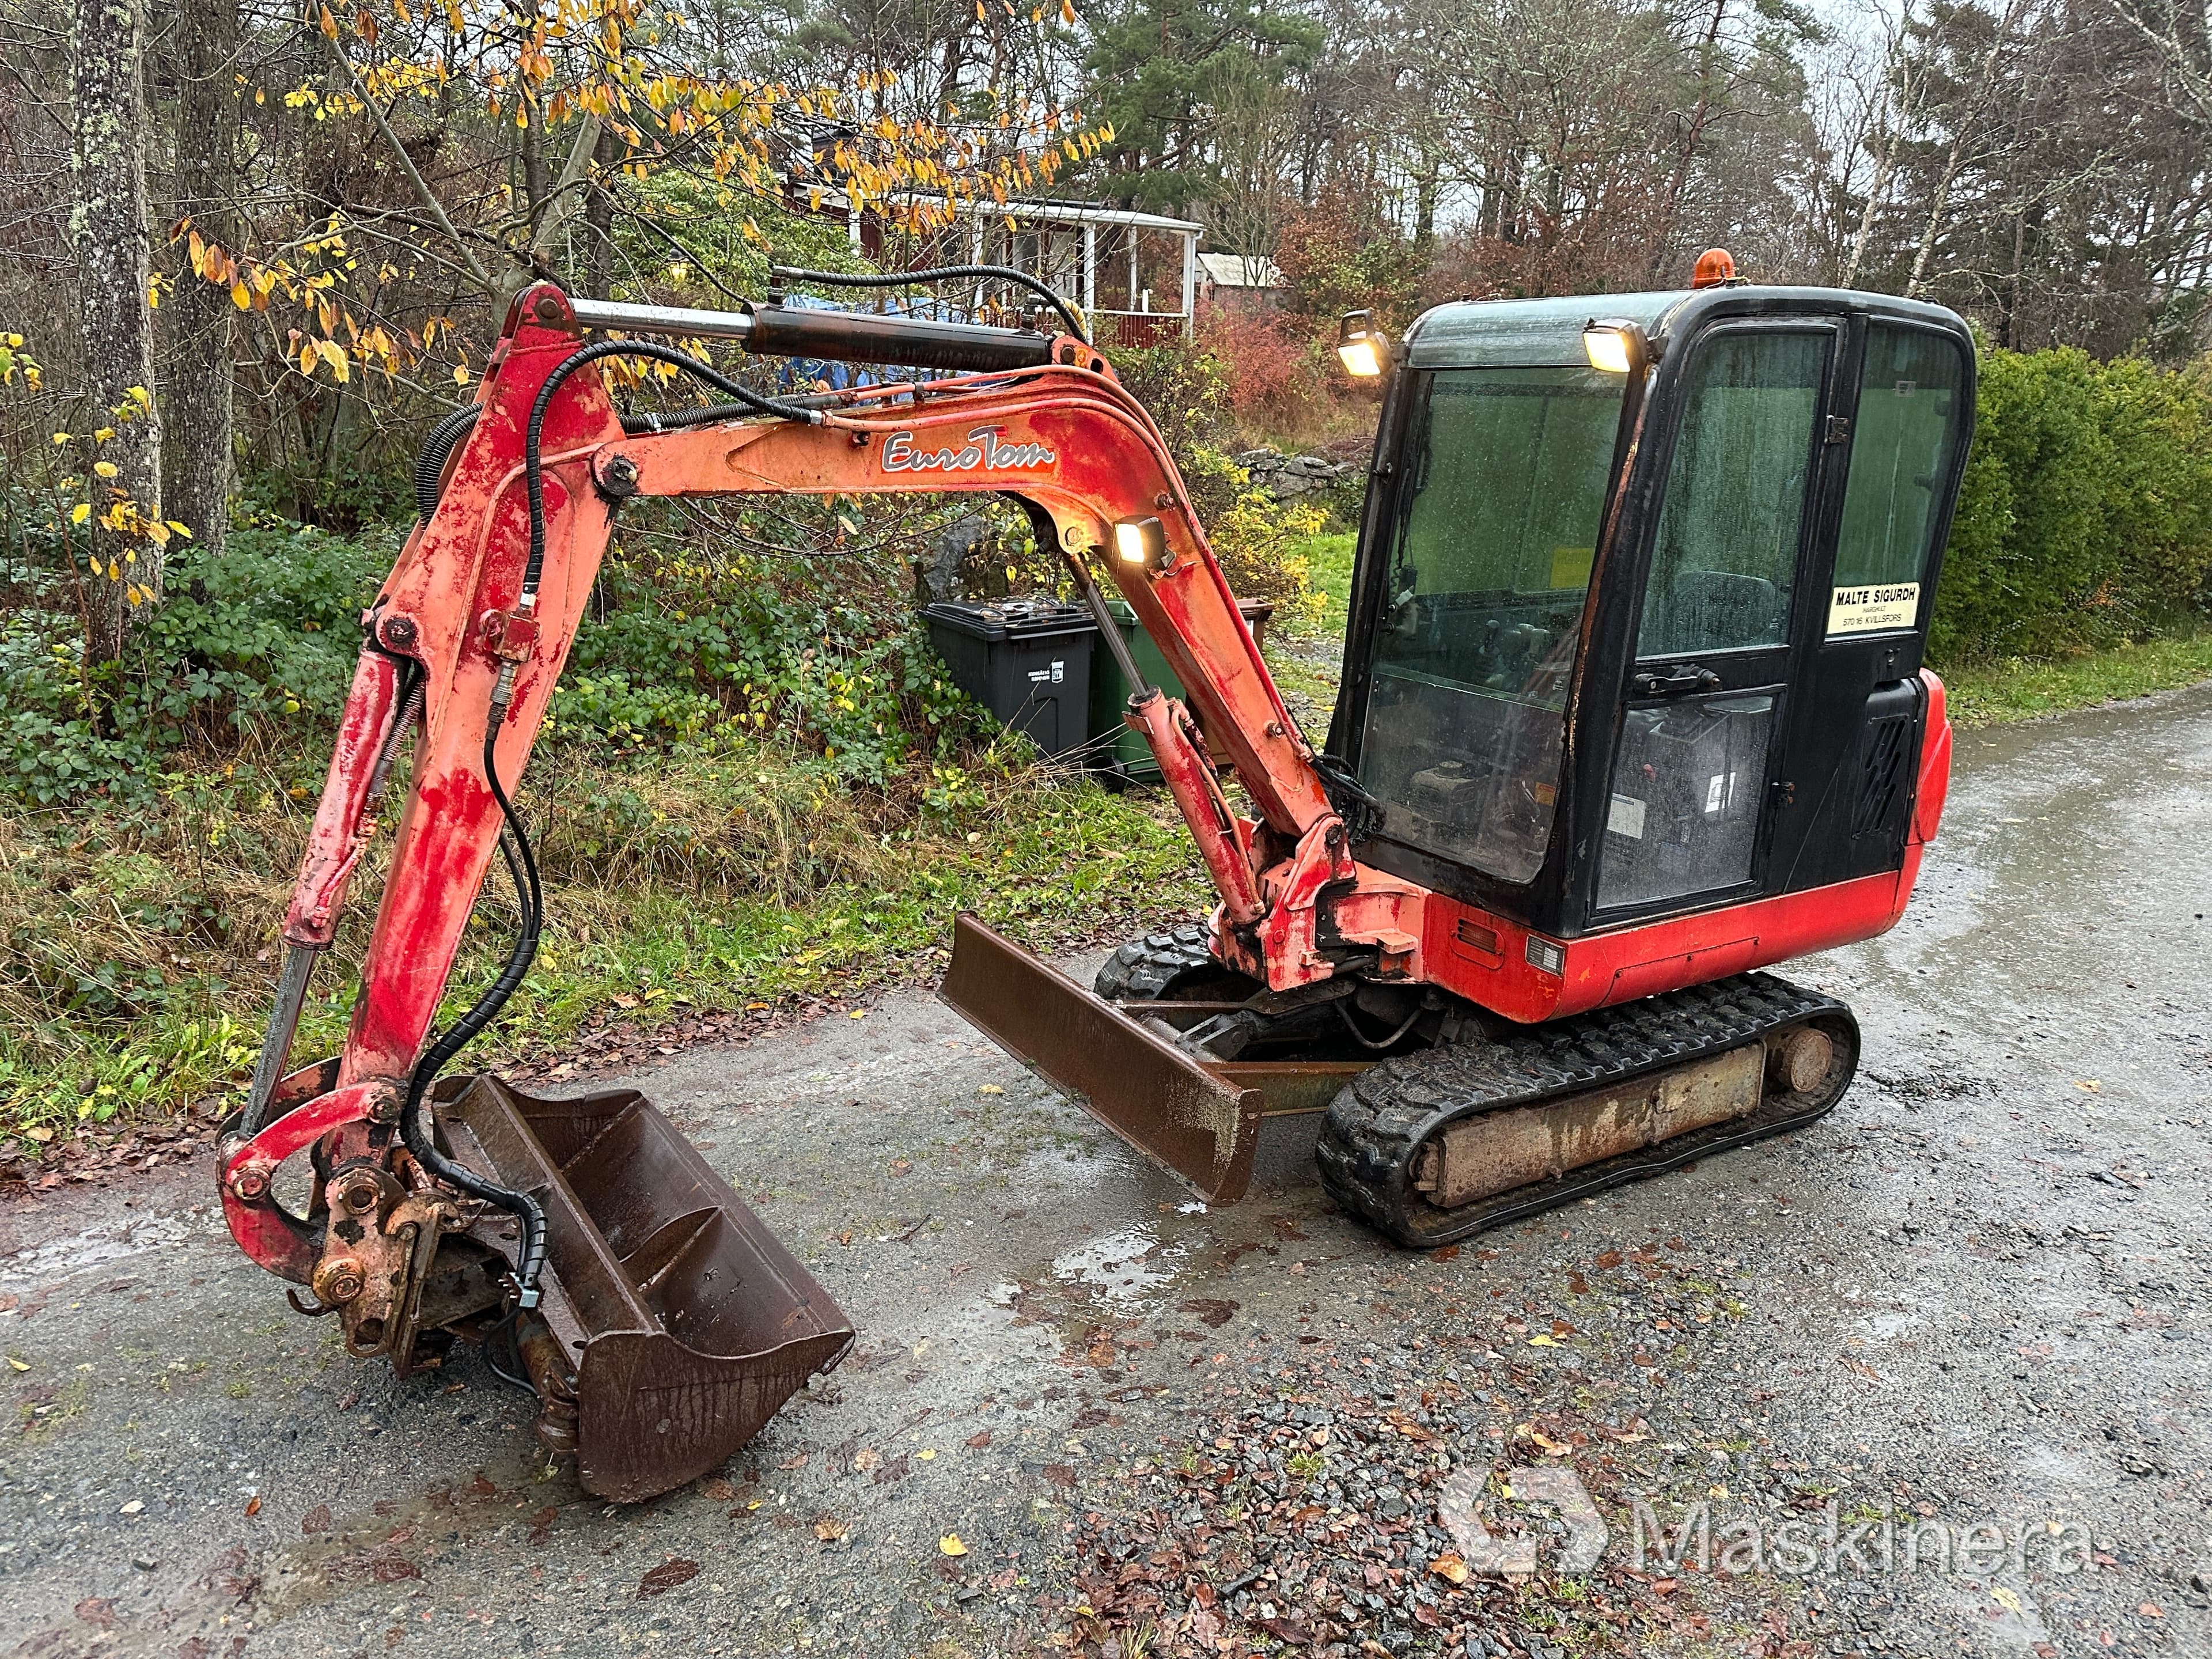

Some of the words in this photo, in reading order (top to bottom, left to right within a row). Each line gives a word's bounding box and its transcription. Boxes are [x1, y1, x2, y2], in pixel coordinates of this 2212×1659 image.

[882, 425, 1055, 471] EuroTom
[1836, 590, 1869, 605] MALTE
[1873, 588, 1916, 603] SIGURDH
[1865, 613, 1902, 624] KVILLSFORS
